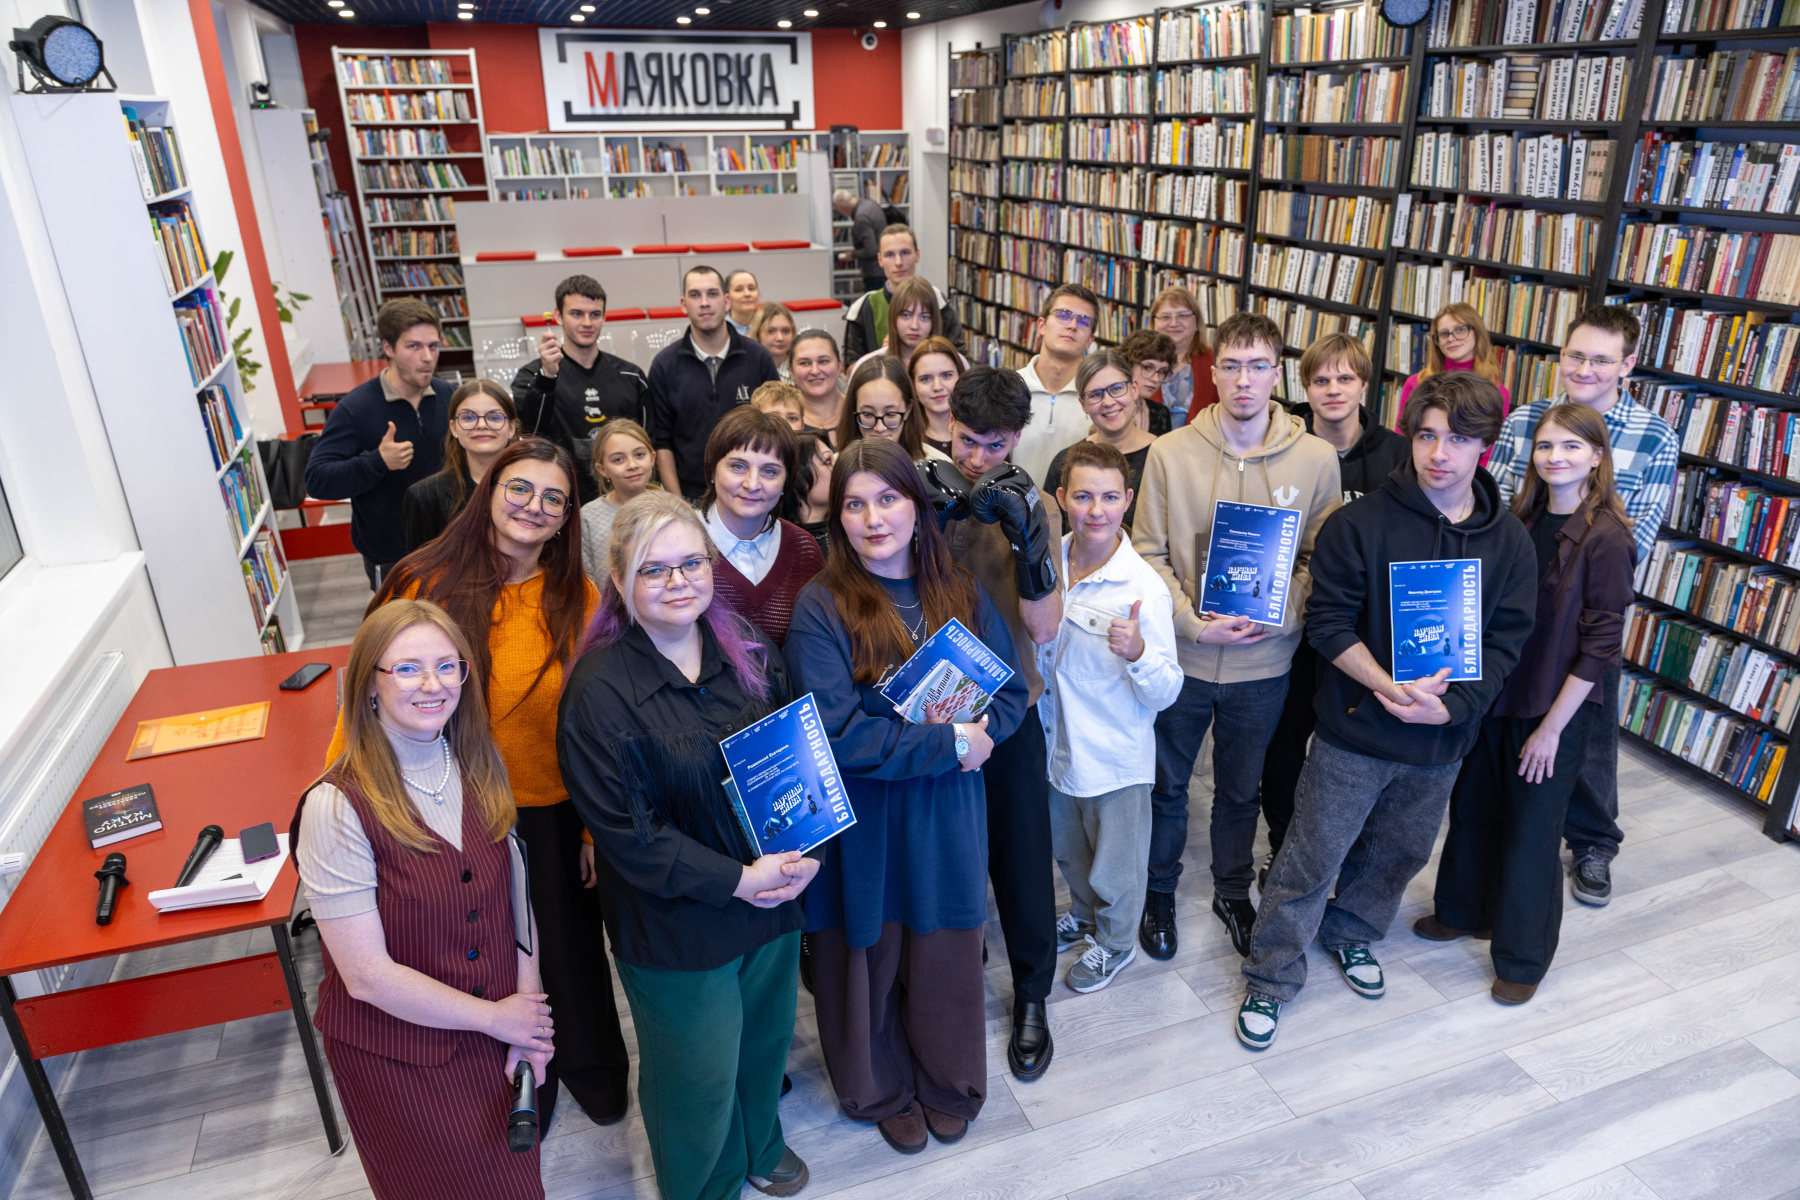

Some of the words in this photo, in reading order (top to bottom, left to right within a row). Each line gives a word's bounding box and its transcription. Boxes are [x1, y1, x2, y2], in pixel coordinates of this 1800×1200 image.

[1511, 5, 1523, 43] Брамс
[1522, 1, 1535, 44] Вагнер
[585, 51, 779, 107] МАЯКОВКА
[1493, 82, 1502, 118] Моцарт
[1548, 59, 1561, 120] Огиньский
[1556, 76, 1568, 120] Паганини
[1574, 76, 1585, 120] Пуччини
[1586, 78, 1600, 121] Равель
[1594, 59, 1604, 75] М.
[1607, 74, 1619, 121] Россини
[1464, 87, 1472, 114] Лист
[1423, 146, 1432, 187] Сметана
[1478, 136, 1488, 192] Чюрлёнис
[1494, 154, 1503, 193] Шопен
[1525, 156, 1535, 196] Штраус
[1537, 152, 1548, 194] Штраус
[1548, 157, 1559, 198] Шуберт
[1570, 158, 1581, 200] Шуман
[1268, 515, 1296, 619] БЛАГОДАРНОСТЬ
[1463, 565, 1477, 674] БЛАГОДАРНОСТЬ
[944, 624, 1008, 682] БЛАГОДАРНОСТЬ
[1748, 662, 1760, 680] театр
[920, 687, 936, 713] СРЕДА
[931, 668, 954, 705] ОБИТАНИЯ
[798, 702, 850, 823] БЛАГОДАРНОСТЬ
[94, 812, 153, 834] МИТИО
[100, 810, 144, 827] КАКУ
